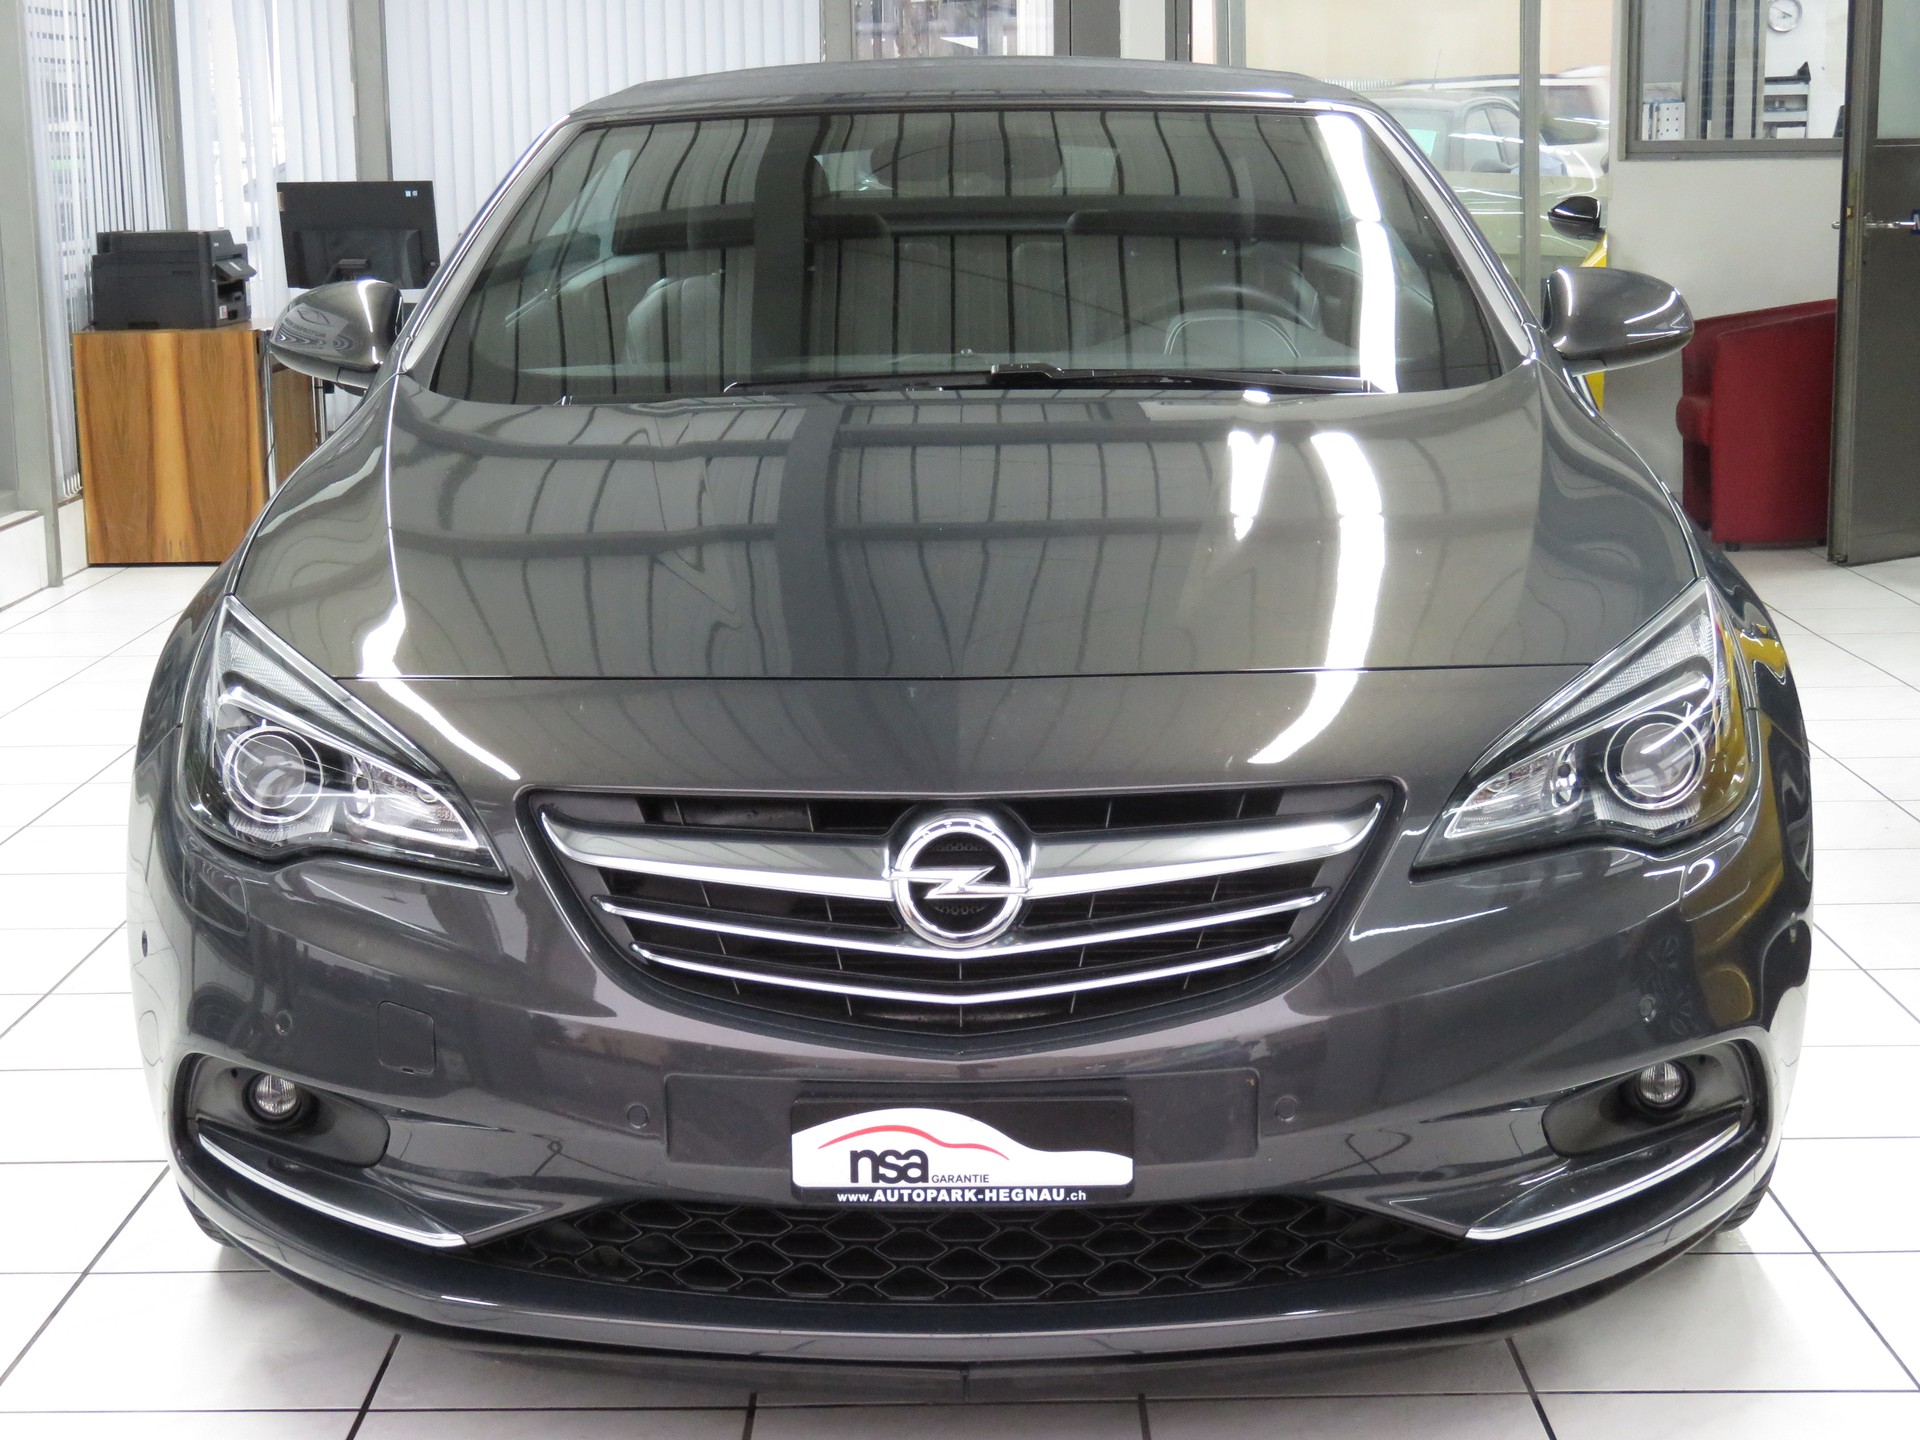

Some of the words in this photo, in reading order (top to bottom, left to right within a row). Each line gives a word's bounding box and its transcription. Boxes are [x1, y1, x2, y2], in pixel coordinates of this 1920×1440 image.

[850, 1149, 929, 1184] nsa
[931, 1174, 989, 1184] GARANTIE
[837, 1188, 1086, 1202] www.AUTOPARK-HEGNAU.ch
